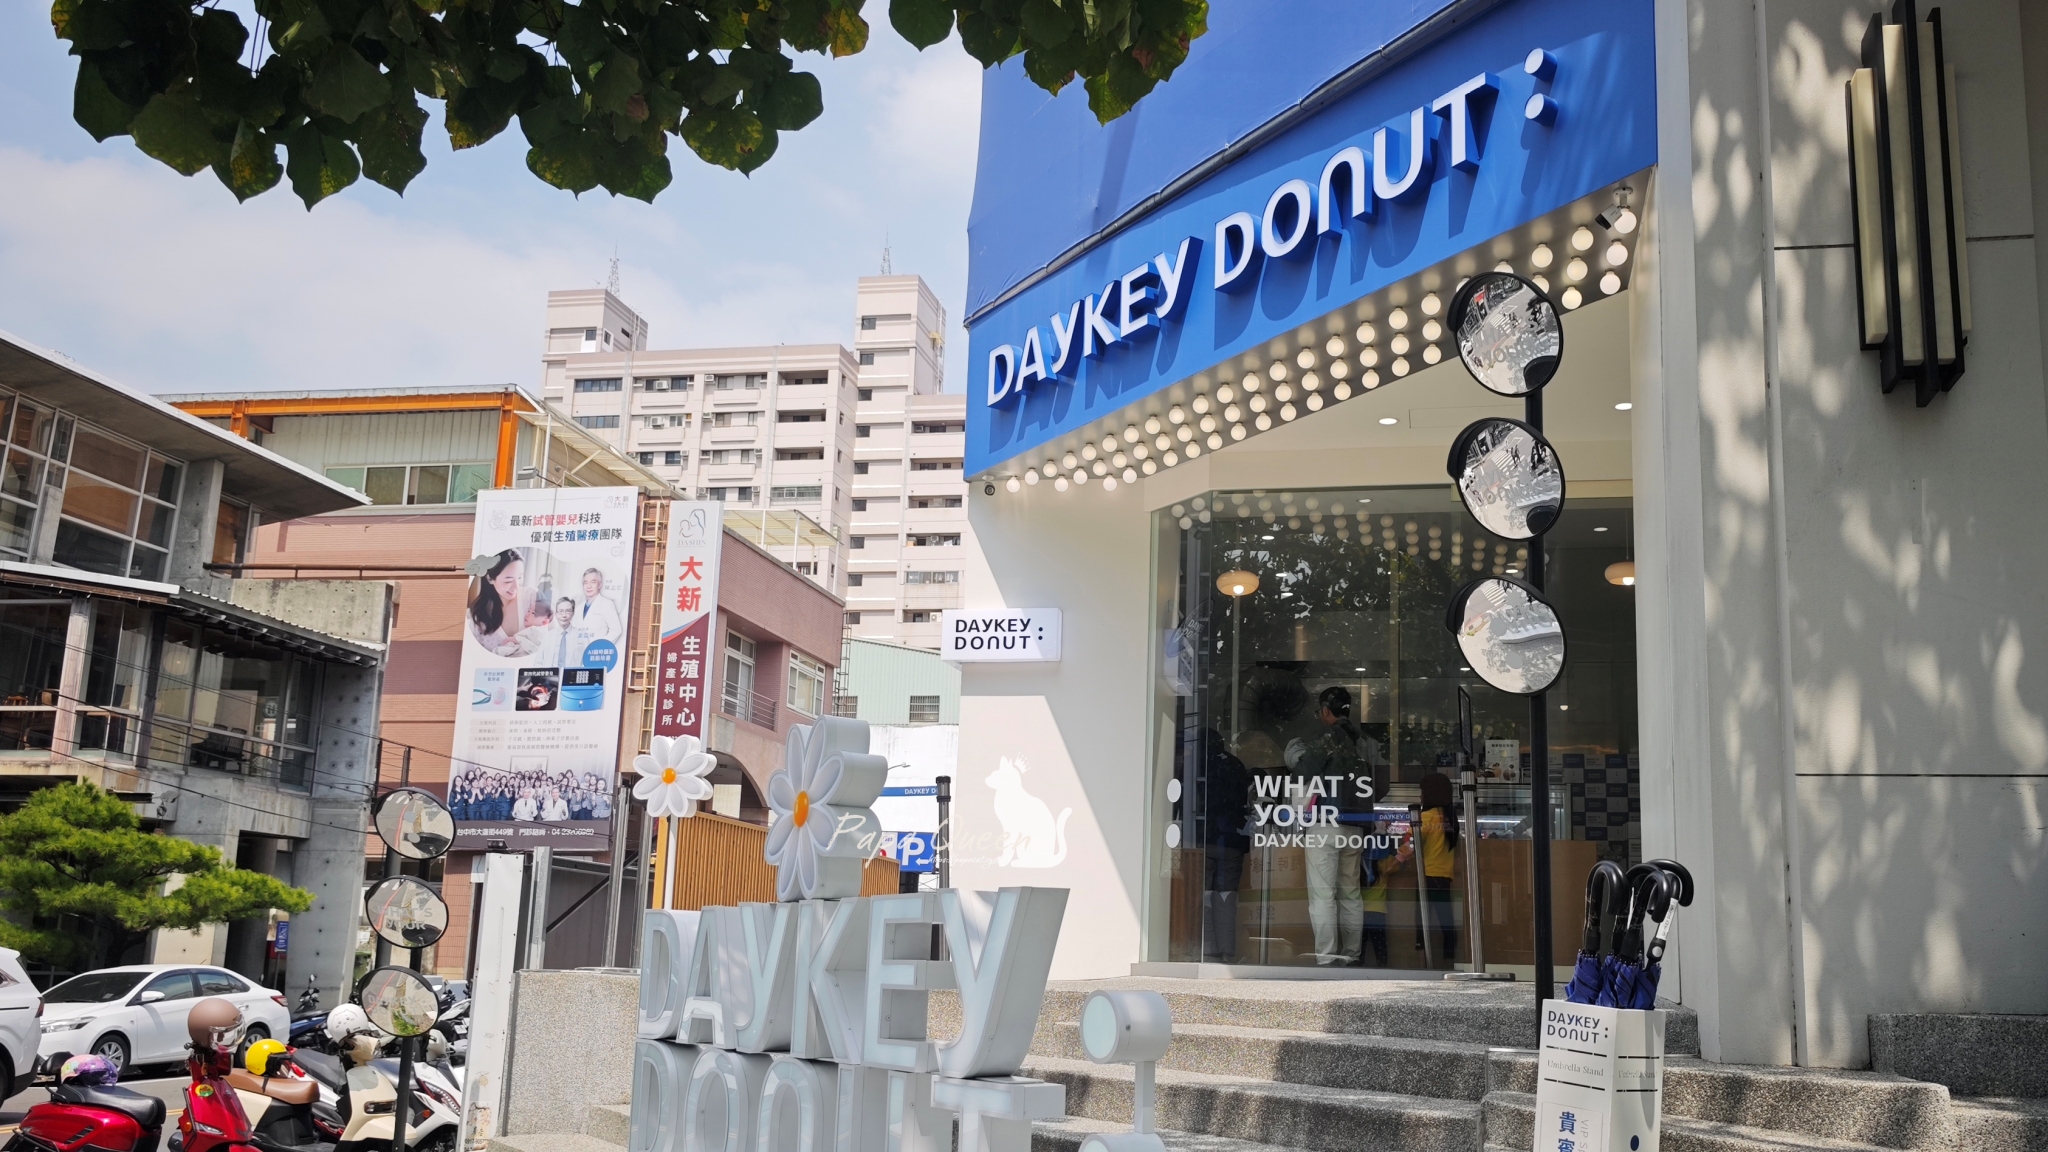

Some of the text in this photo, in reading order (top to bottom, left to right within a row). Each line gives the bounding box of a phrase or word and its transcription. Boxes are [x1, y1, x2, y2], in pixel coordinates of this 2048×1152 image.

[987, 236, 1203, 408] DAYKEY
[510, 512, 601, 527] 最新試管嬰兒科技
[530, 528, 623, 543] 優質生殖醫療團隊
[676, 556, 703, 612] 大新
[955, 618, 1031, 633] DAYKEY
[661, 652, 678, 726] 婦產科診所
[676, 635, 700, 726] 生殖中心
[1253, 773, 1374, 798] WHAT'S
[1253, 804, 1340, 828] YOUR
[902, 837, 925, 866] P
[1254, 834, 1328, 848] DAYKEY
[636, 887, 1070, 1078] DAYKEY
[1548, 1010, 1600, 1030] DAYKEY
[1547, 1059, 1604, 1076] Umbrella Stand
[1580, 1119, 1589, 1138] VIP
